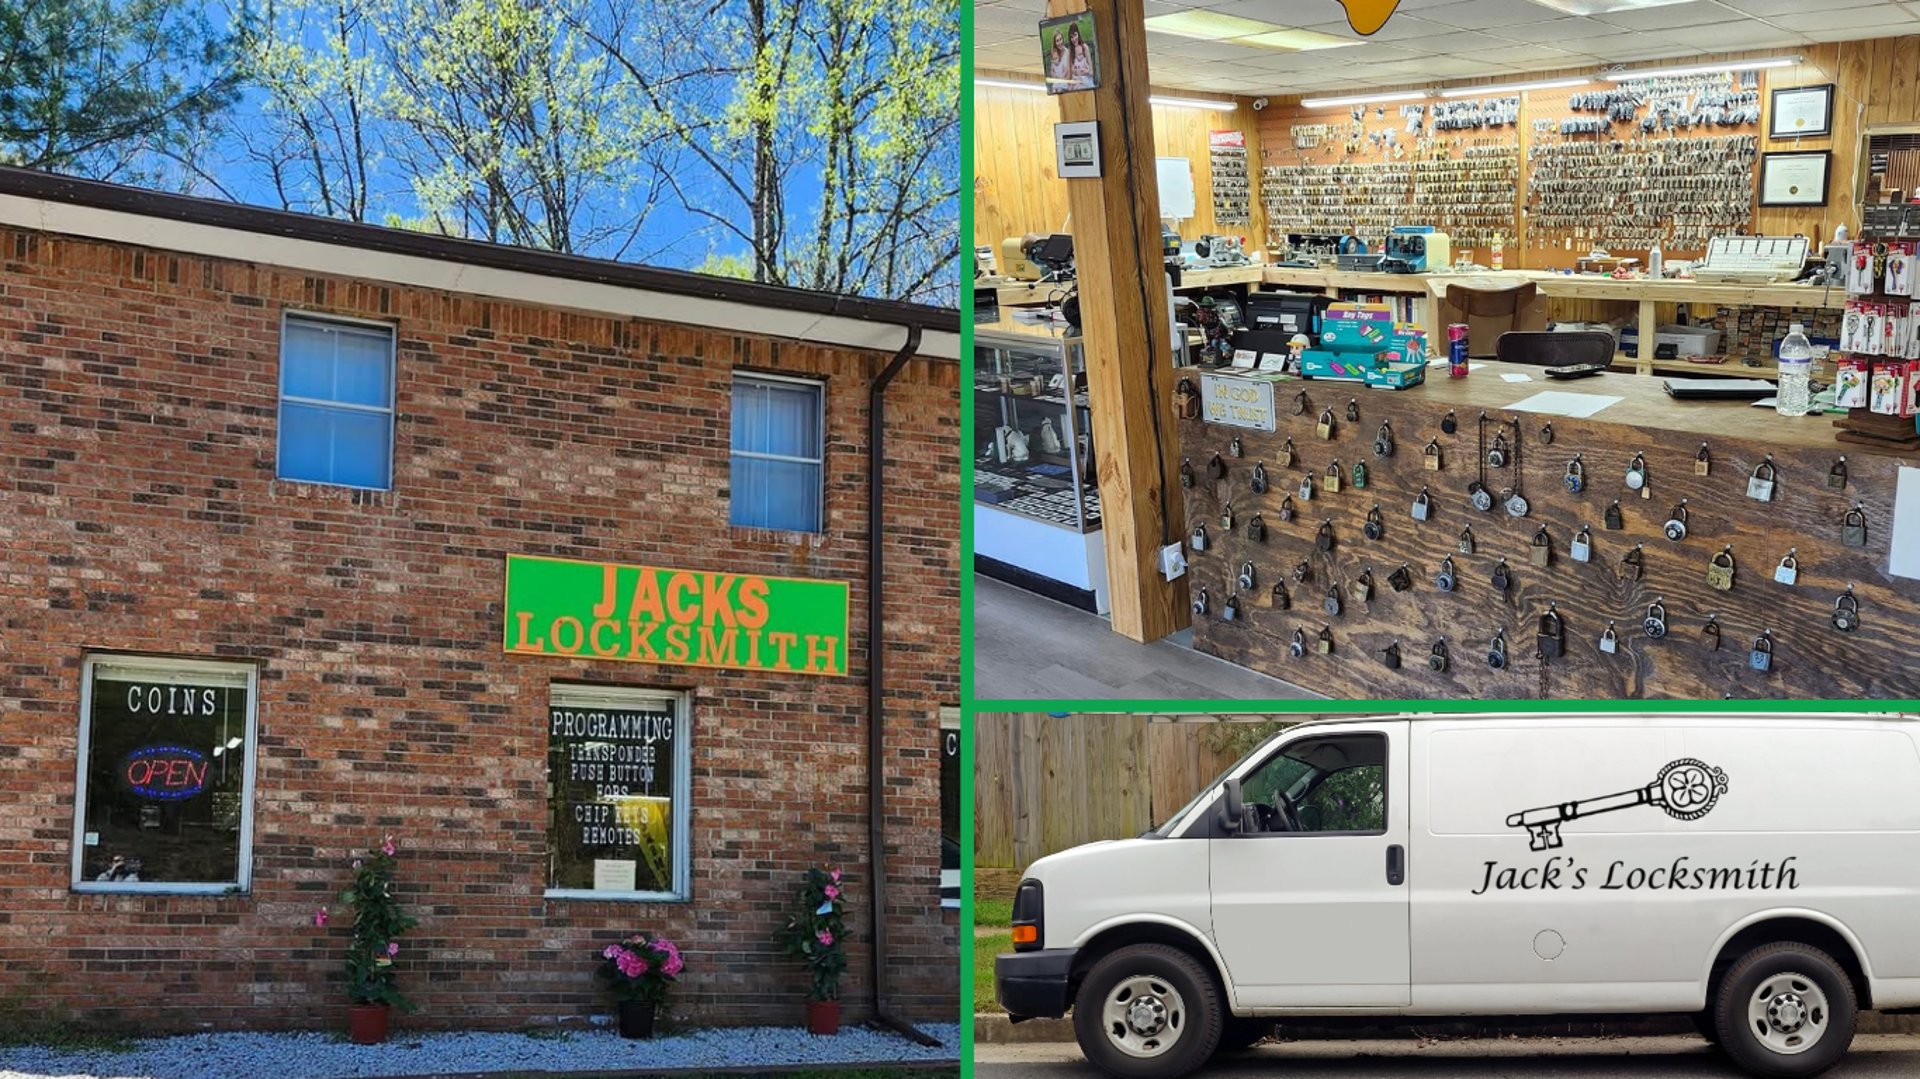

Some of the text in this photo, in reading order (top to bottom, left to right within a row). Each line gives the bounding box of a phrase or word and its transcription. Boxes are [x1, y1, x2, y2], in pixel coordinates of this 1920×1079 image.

[1214, 383, 1259, 403] IN GOD
[1208, 401, 1267, 423] WE TRUST
[593, 563, 771, 629] JACKS
[514, 611, 839, 673] LOCKSMITH
[127, 685, 216, 715] COINS
[552, 711, 672, 741] PROGRAMMING
[127, 759, 208, 787] OPEN
[571, 763, 655, 782] PUSH BUTTON
[575, 805, 649, 824] CHIP KEYS
[582, 827, 640, 845] REMOTES
[1471, 856, 1800, 895] Jack's Locksmith
